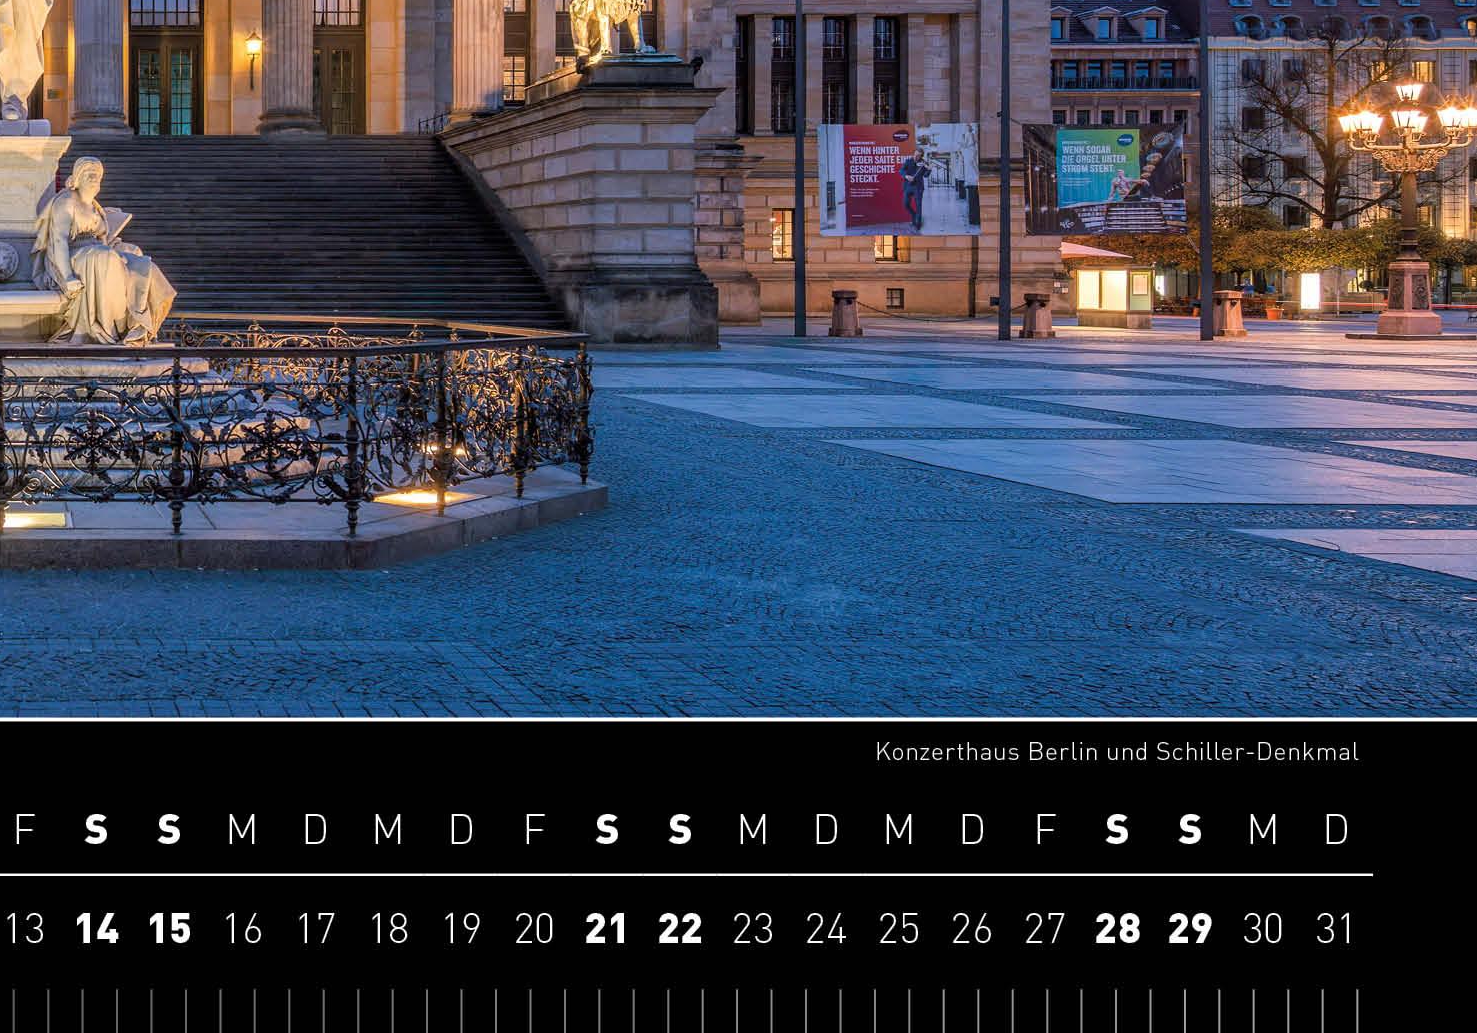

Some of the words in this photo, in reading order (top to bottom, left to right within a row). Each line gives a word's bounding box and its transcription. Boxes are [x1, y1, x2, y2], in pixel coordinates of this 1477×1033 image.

[849, 146, 871, 155] WENN
[873, 146, 900, 155] HINTER
[1062, 145, 1084, 154] WENN
[850, 155, 873, 164] JEDER
[875, 155, 895, 164] SAITE
[1061, 154, 1075, 164] DIE
[1076, 154, 1100, 163] ORGEL
[1102, 154, 1126, 163] UNTER
[850, 164, 895, 173] GESCHICHTE
[1061, 164, 1089, 173] STROM
[850, 174, 880, 183] STECKT.
